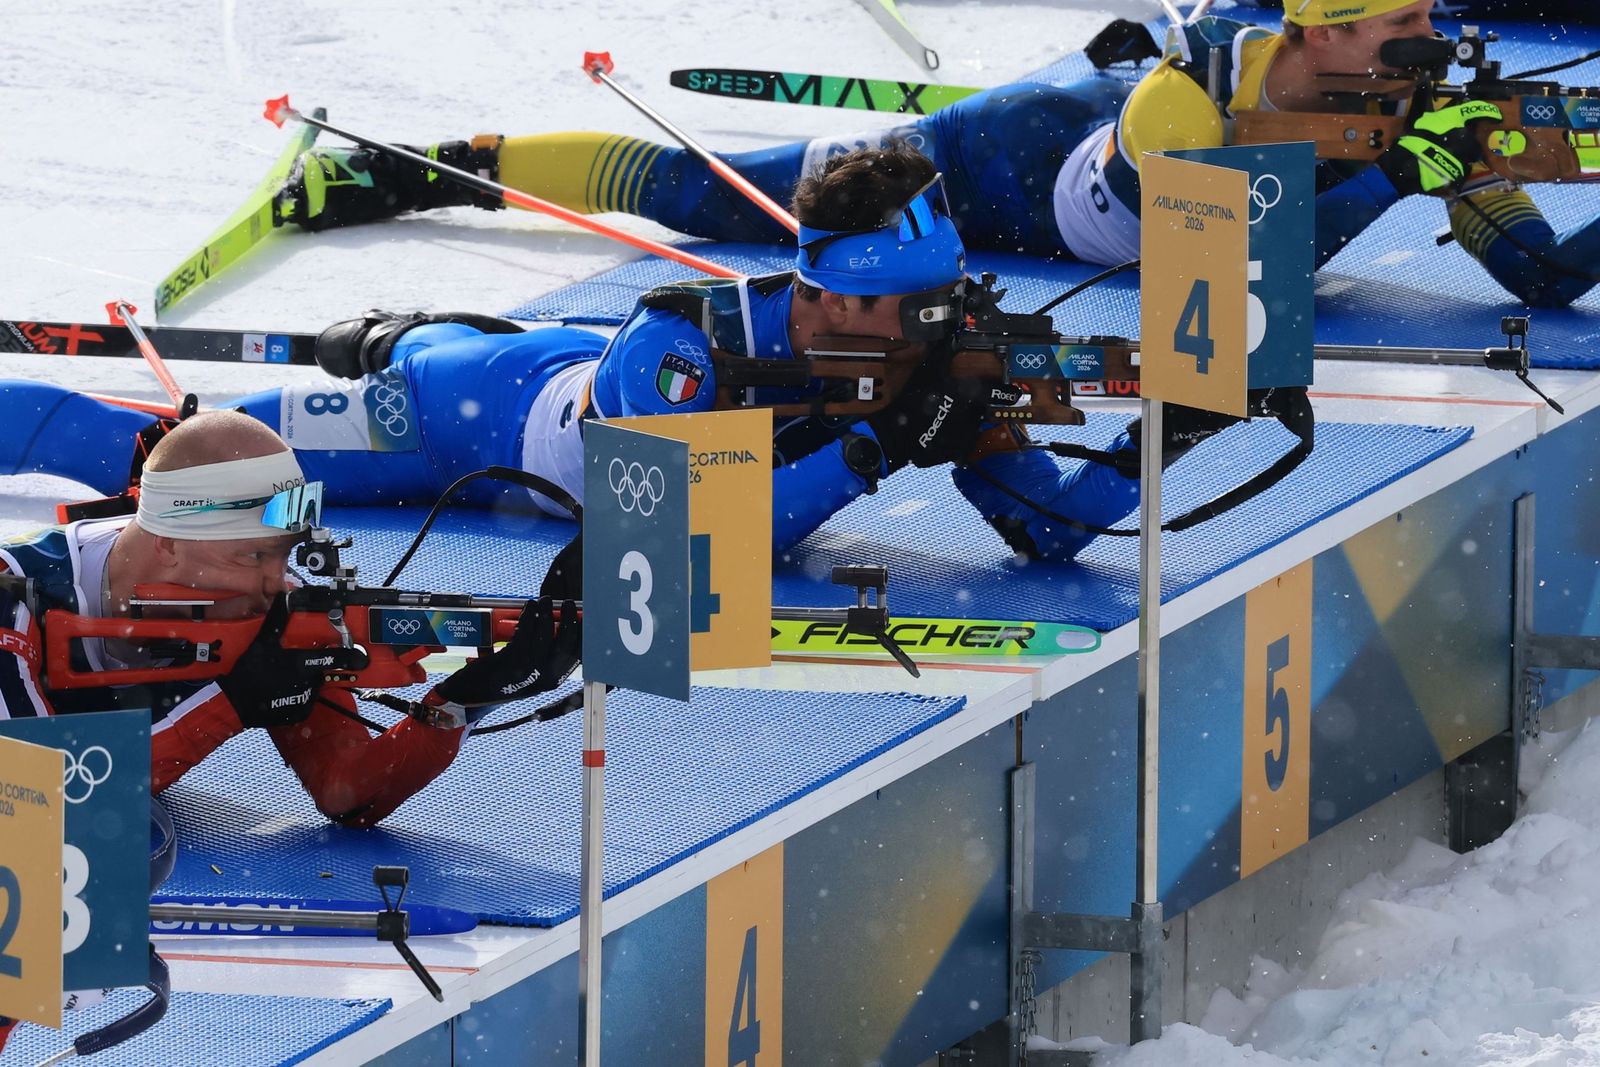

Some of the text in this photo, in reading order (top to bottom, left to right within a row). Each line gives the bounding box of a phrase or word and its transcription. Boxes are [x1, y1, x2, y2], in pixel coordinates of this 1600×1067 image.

[687, 71, 928, 115] SPEED MAX
[1152, 195, 1237, 222] MILANO CORTINA
[1184, 216, 1205, 231] 2026
[848, 255, 881, 267] EA7
[1173, 278, 1215, 375] 4
[271, 344, 284, 353] 8
[303, 392, 350, 416] 8
[689, 449, 760, 468] CORTINA
[173, 499, 205, 507] CRAFT
[617, 550, 655, 656] 3
[443, 619, 473, 627] MILANO
[447, 625, 478, 633] CORTINA
[1264, 633, 1291, 793] 5
[727, 924, 761, 1067] 4
